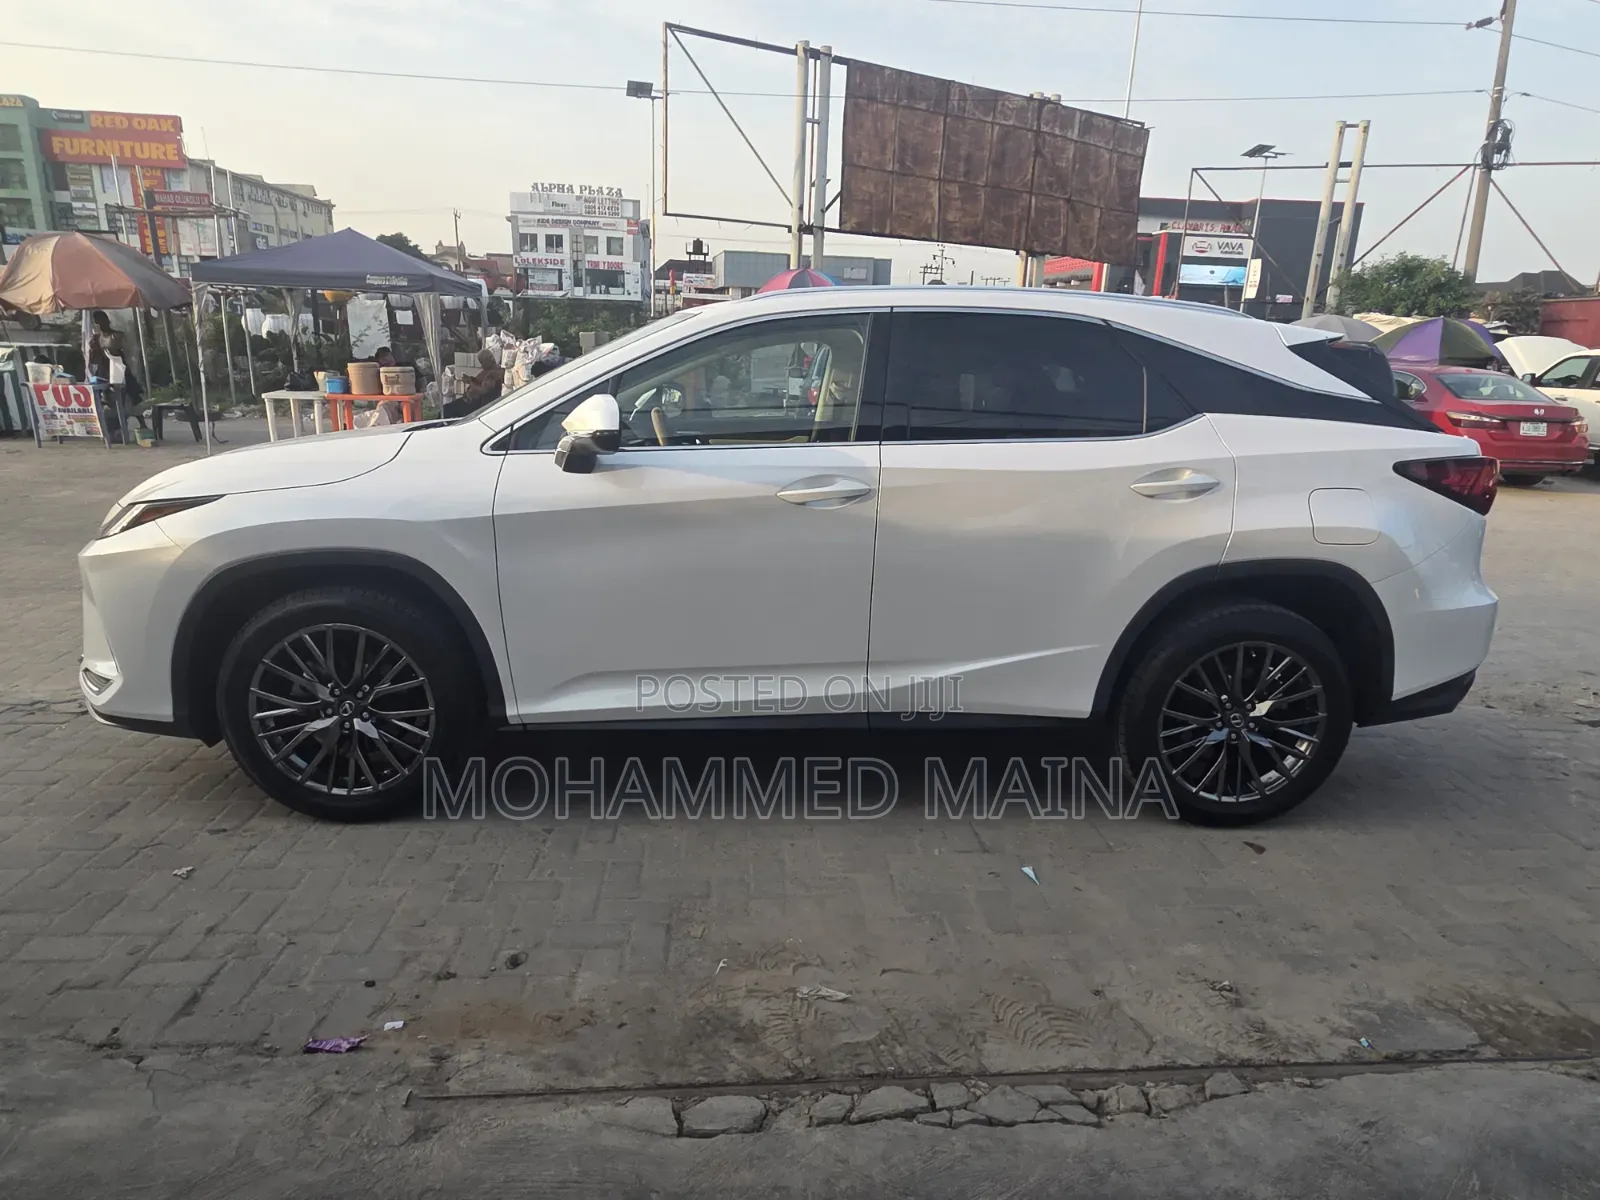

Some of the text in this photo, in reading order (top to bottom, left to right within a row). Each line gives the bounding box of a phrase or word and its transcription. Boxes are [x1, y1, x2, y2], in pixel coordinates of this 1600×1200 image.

[91, 114, 129, 130] RED
[132, 117, 175, 132] OAK
[51, 136, 179, 160] FURNITURE
[531, 182, 623, 197] ALPHA PLAZA
[1217, 241, 1244, 251] VAVA
